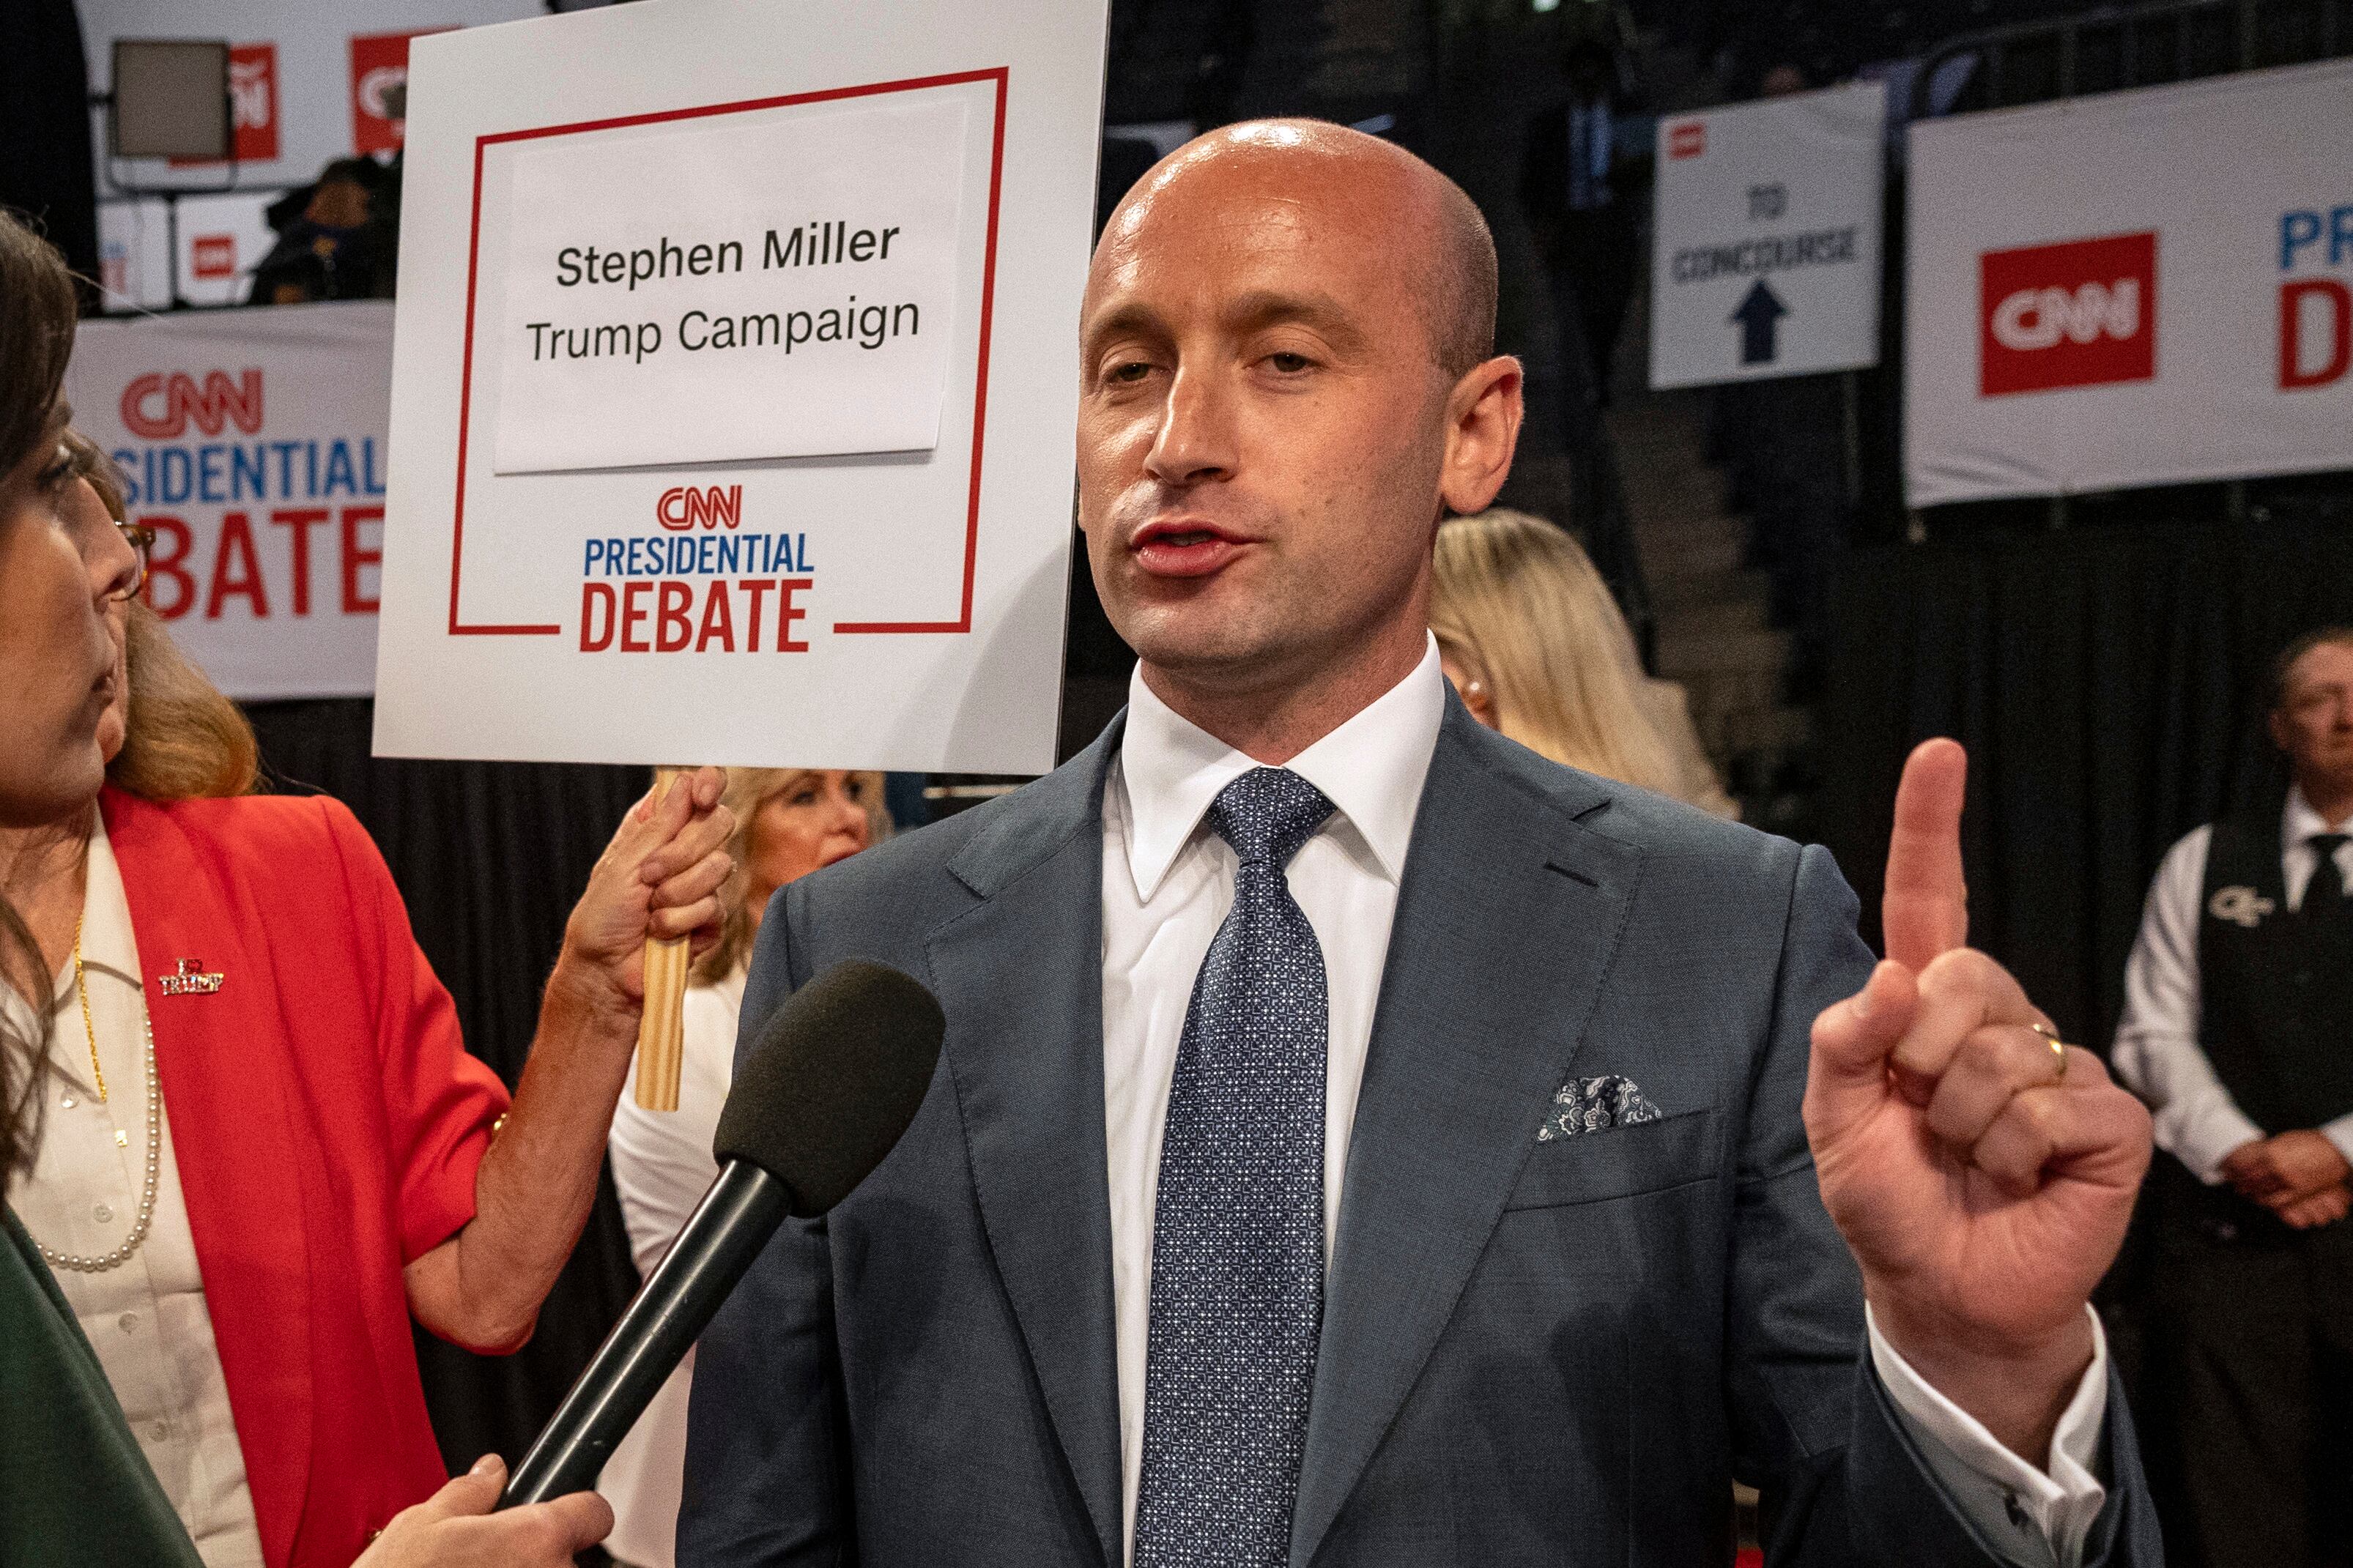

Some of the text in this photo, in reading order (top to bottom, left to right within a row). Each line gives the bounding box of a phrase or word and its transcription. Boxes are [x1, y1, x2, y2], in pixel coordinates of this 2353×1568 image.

[556, 220, 900, 291] Stephen Miller
[1671, 228, 1859, 284] CONCOURSE
[525, 294, 920, 365] Trump Campaign
[1991, 278, 2142, 351] CNN
[119, 368, 264, 441] CNN
[656, 484, 743, 531] CNN
[584, 532, 815, 576] PRESIDENTIAL
[579, 578, 814, 653] DEBATE
[158, 973, 224, 996] TRUMP
